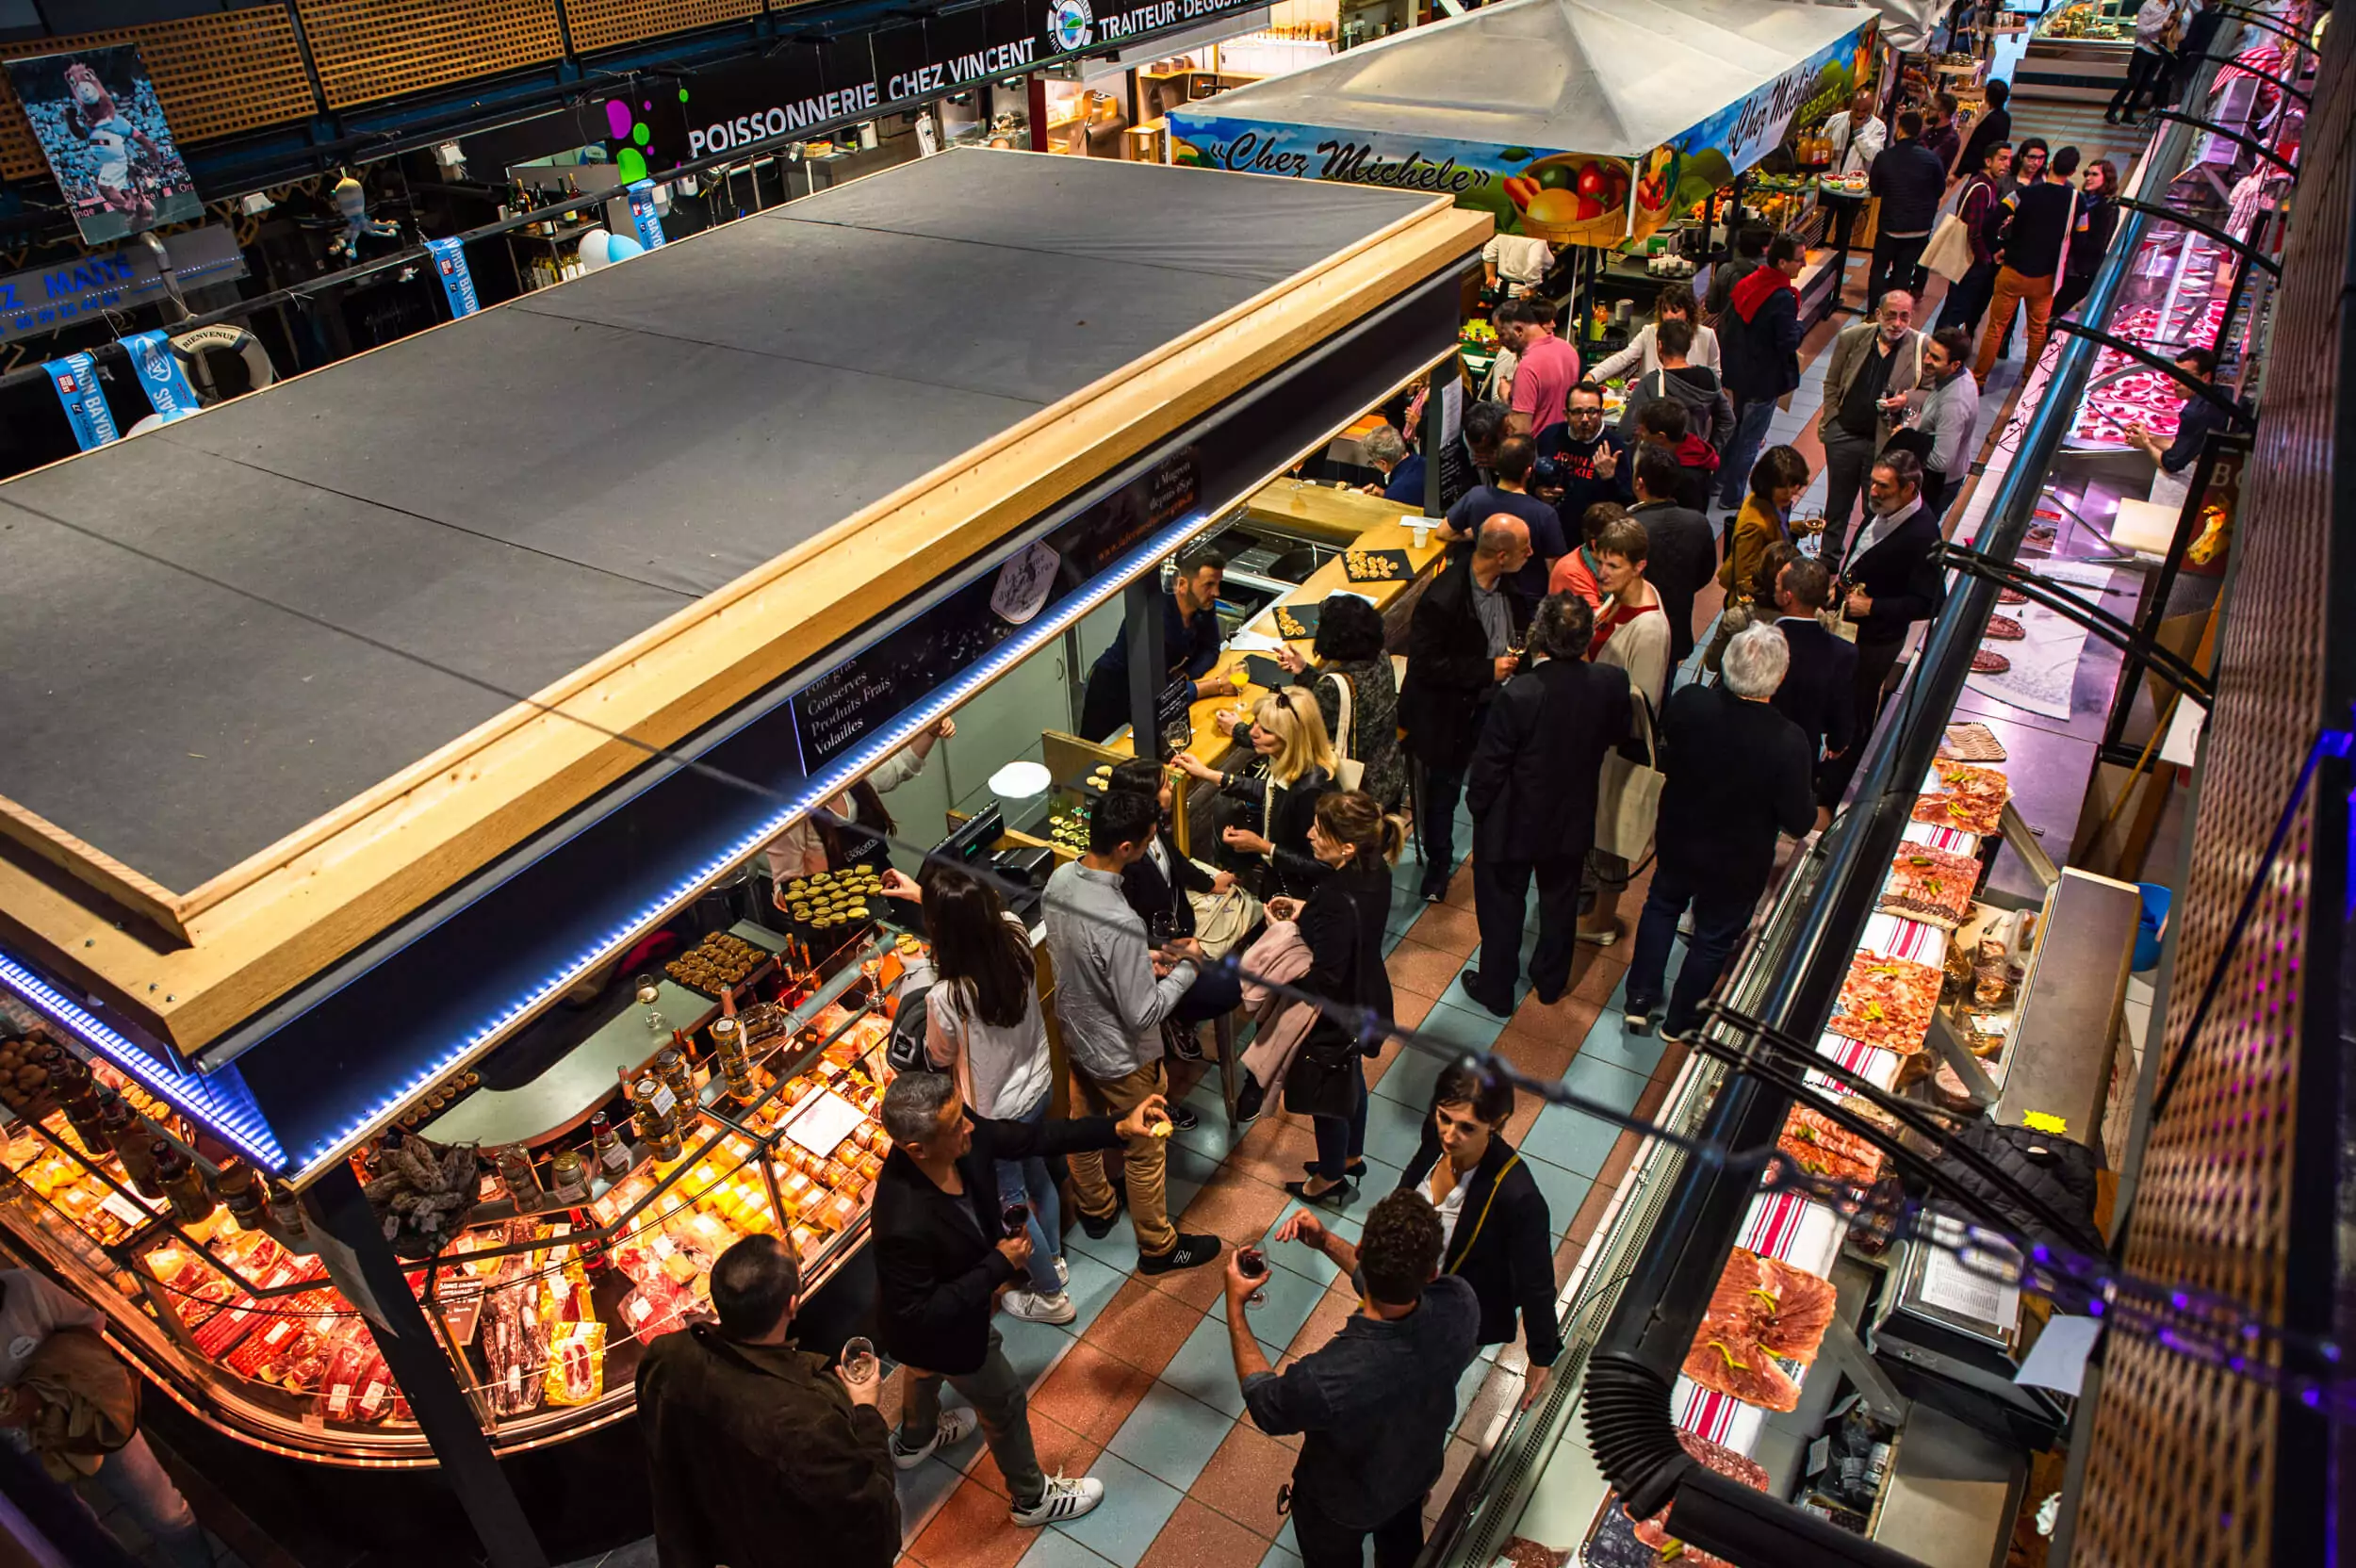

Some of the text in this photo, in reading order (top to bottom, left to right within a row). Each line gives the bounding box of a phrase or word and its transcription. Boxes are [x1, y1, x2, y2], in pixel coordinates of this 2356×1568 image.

[1099, 1, 1176, 41] TRAITEUR
[689, 37, 1036, 158] POISSONNERIE CHEZ VINCENT
[0, 285, 25, 311] Z
[182, 331, 237, 349] BIENVENUE
[1553, 451, 1588, 466] JOHN
[1573, 467, 1595, 480] KIE
[808, 672, 868, 716] Conserves
[811, 677, 891, 737] Produits Frais
[814, 718, 864, 755] Volailles
